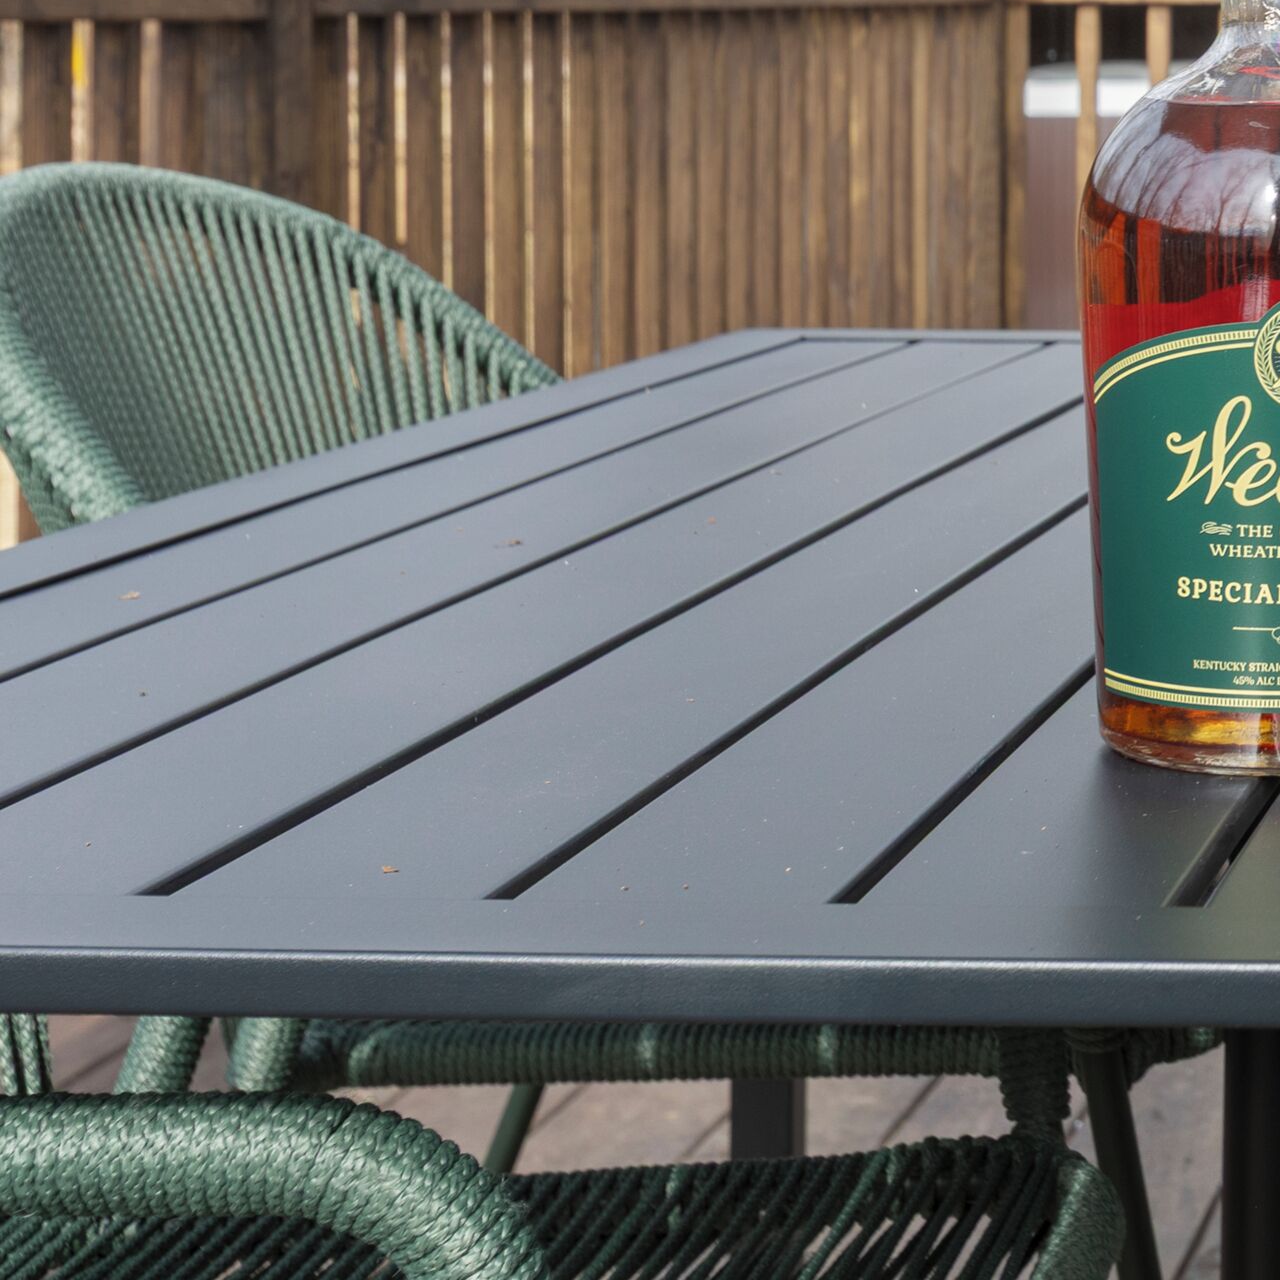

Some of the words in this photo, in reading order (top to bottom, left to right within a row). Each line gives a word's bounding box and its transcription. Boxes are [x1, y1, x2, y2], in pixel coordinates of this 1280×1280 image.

[1236, 524, 1273, 538] THE
[1193, 659, 1247, 672] KENTUCKY
[1233, 675, 1255, 686] 45%
[1256, 676, 1275, 686] ALC
